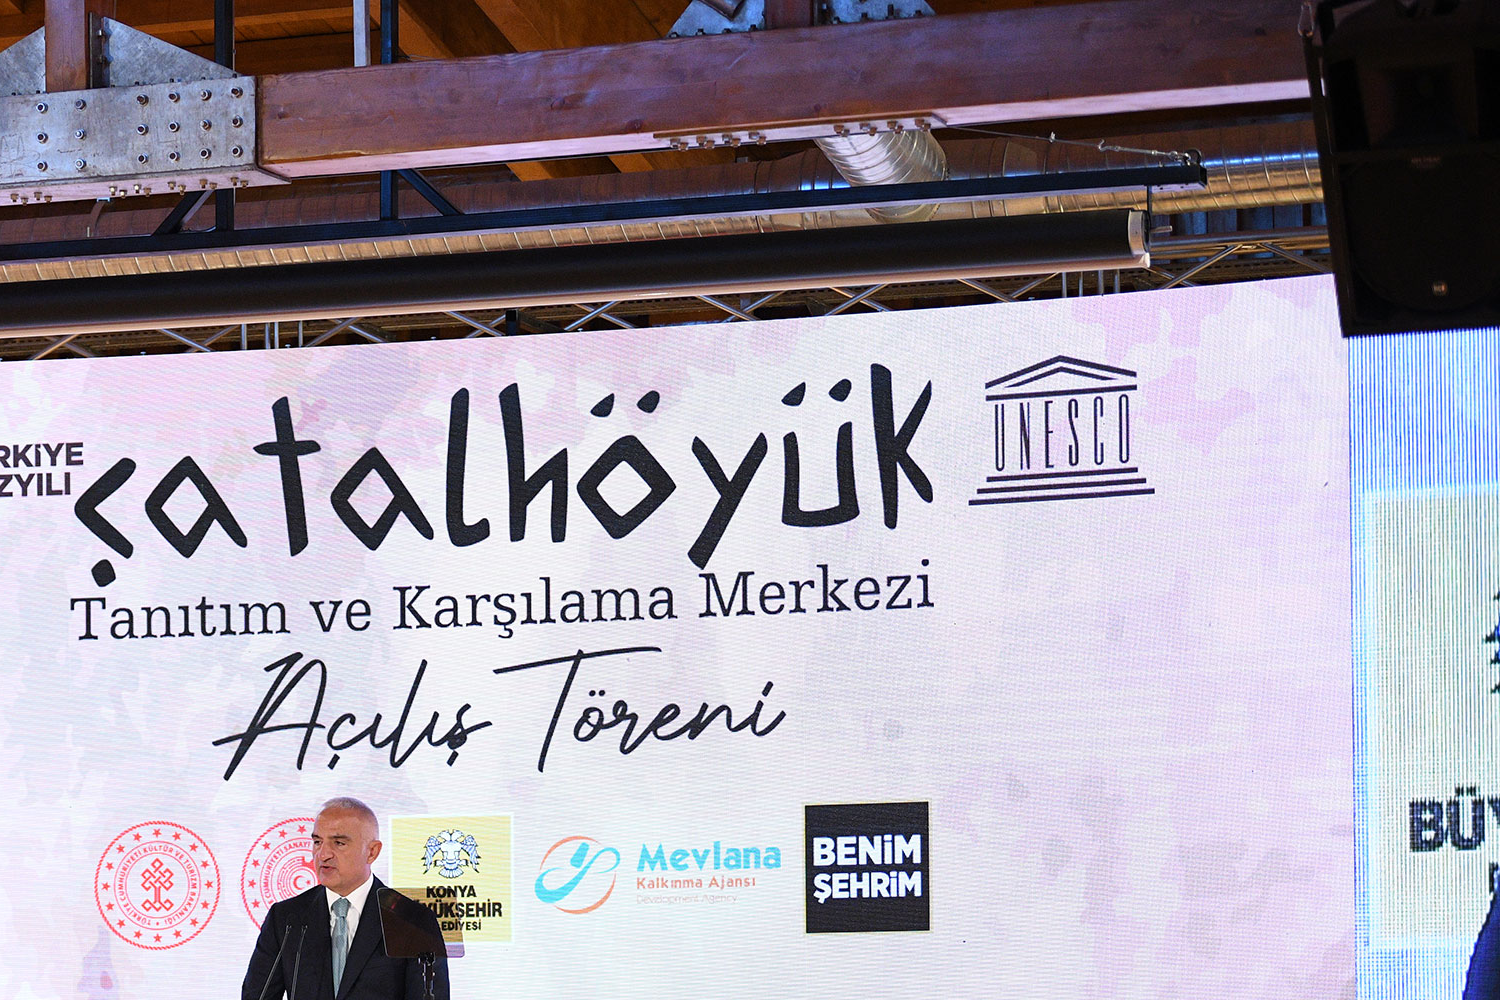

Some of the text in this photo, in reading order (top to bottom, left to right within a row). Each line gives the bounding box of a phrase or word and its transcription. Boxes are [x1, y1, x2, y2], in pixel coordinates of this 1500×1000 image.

[994, 393, 1132, 473] UNESCO
[73, 362, 934, 588] çatalhöyük
[71, 558, 935, 640] Tanıtım ve Karşılama Merkezi
[212, 646, 787, 782] Açılış Töreni
[636, 840, 782, 872] Mevlana
[812, 833, 922, 867] BENİM
[426, 885, 477, 899] KONYA
[636, 875, 757, 891] Kalkınma Ajansı
[813, 871, 922, 904] ŞEHRİM
